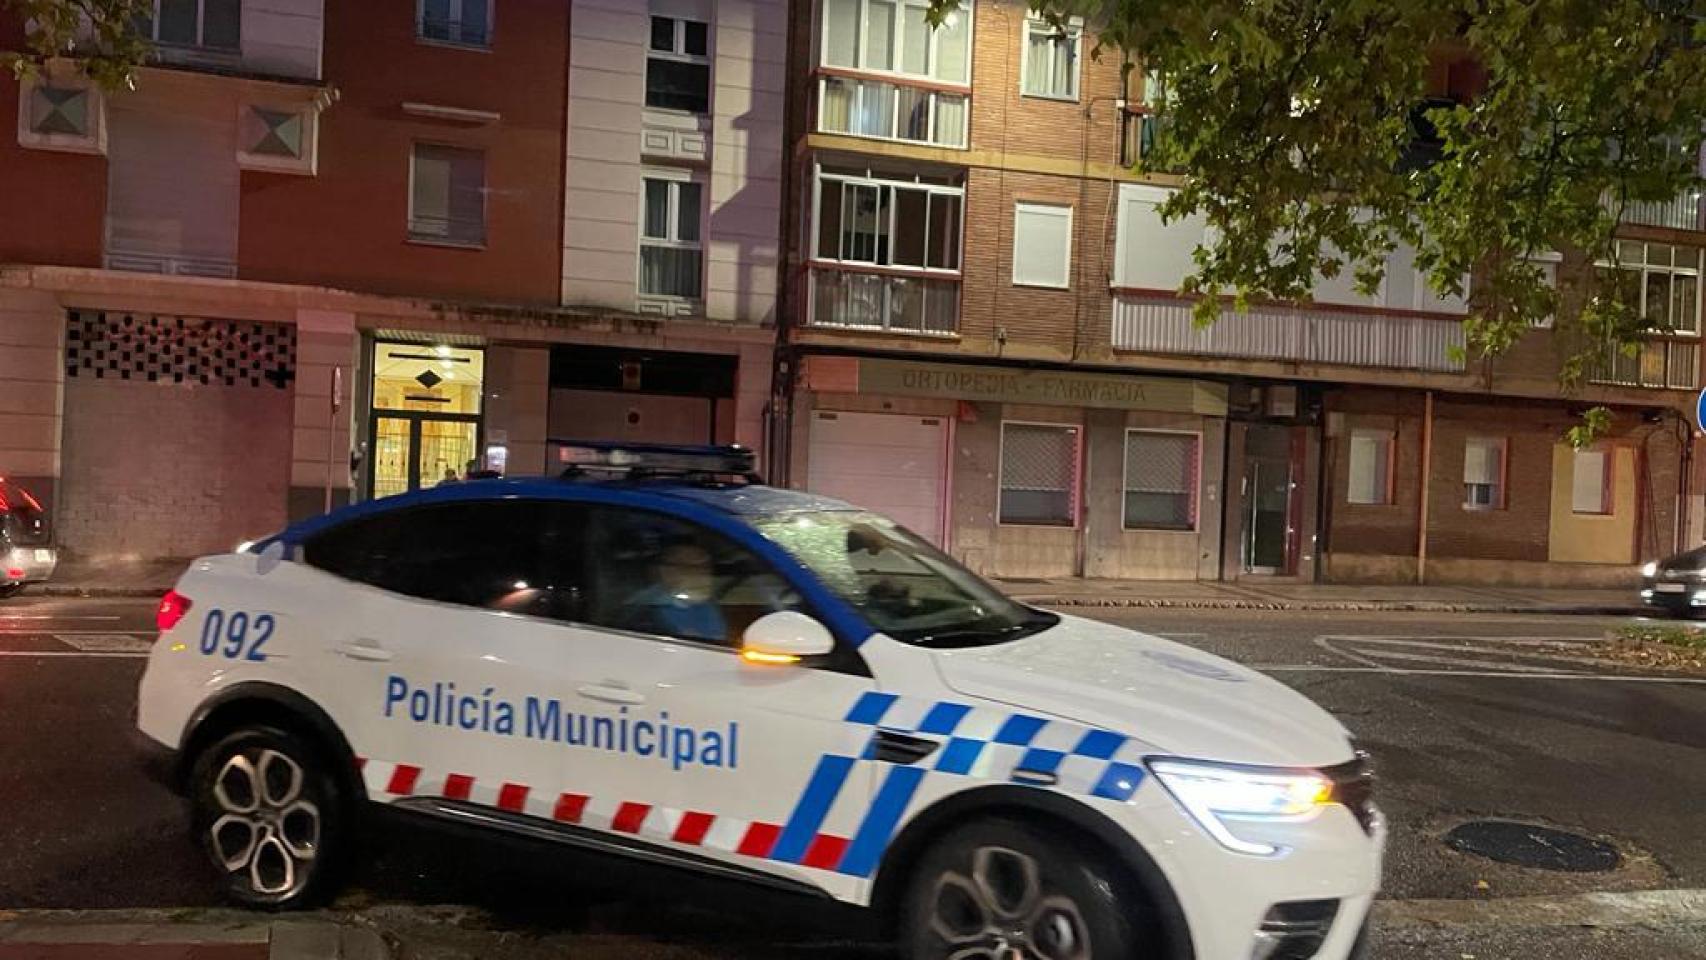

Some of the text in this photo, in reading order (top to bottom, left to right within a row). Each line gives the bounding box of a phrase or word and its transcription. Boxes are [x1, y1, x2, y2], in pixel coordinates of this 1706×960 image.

[902, 369, 1020, 394] ORTOPEDIA
[1043, 378, 1146, 401] FARMACIA
[201, 609, 275, 661] 092
[384, 674, 739, 771] Policía Municipal
